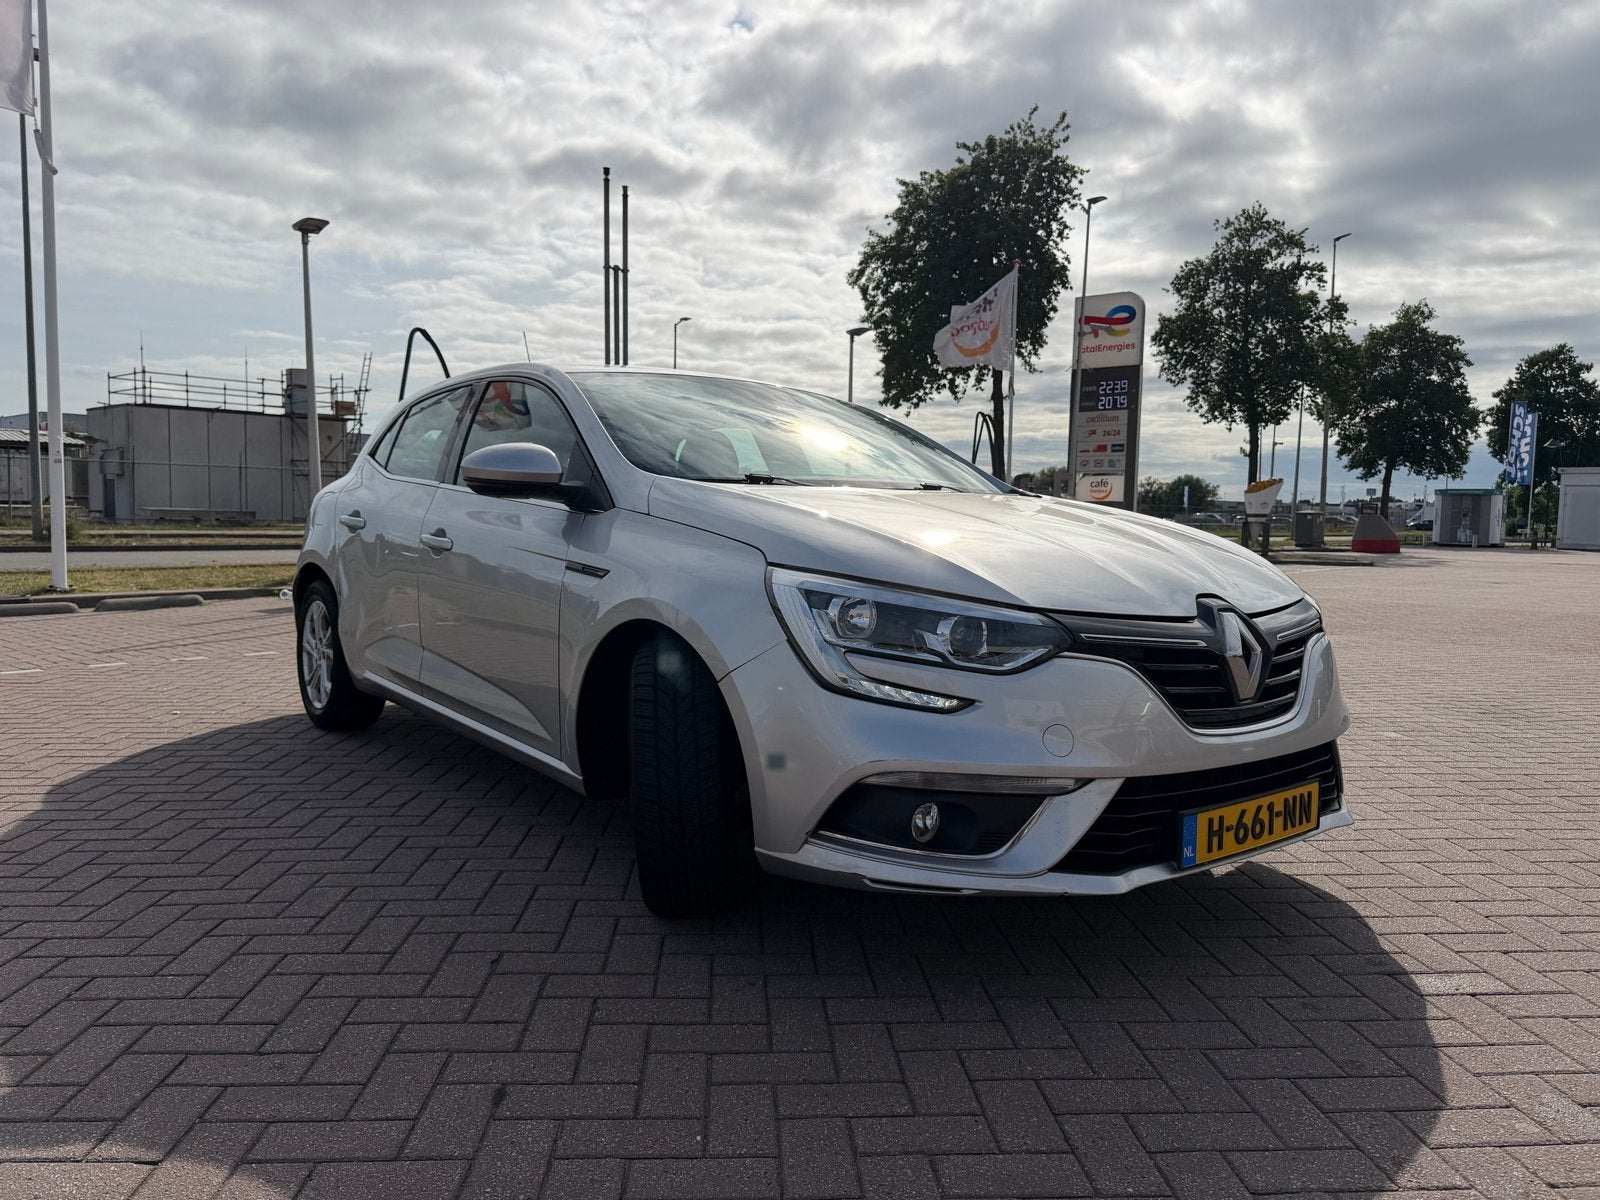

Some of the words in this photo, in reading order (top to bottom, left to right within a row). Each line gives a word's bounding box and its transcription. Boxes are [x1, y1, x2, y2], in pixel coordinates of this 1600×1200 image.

[1081, 342, 1136, 354] otalEnergies
[1507, 404, 1525, 478] SCHOT
[1090, 478, 1109, 488] café
[1207, 790, 1313, 854] H-661-NN
[1183, 847, 1195, 858] NL
